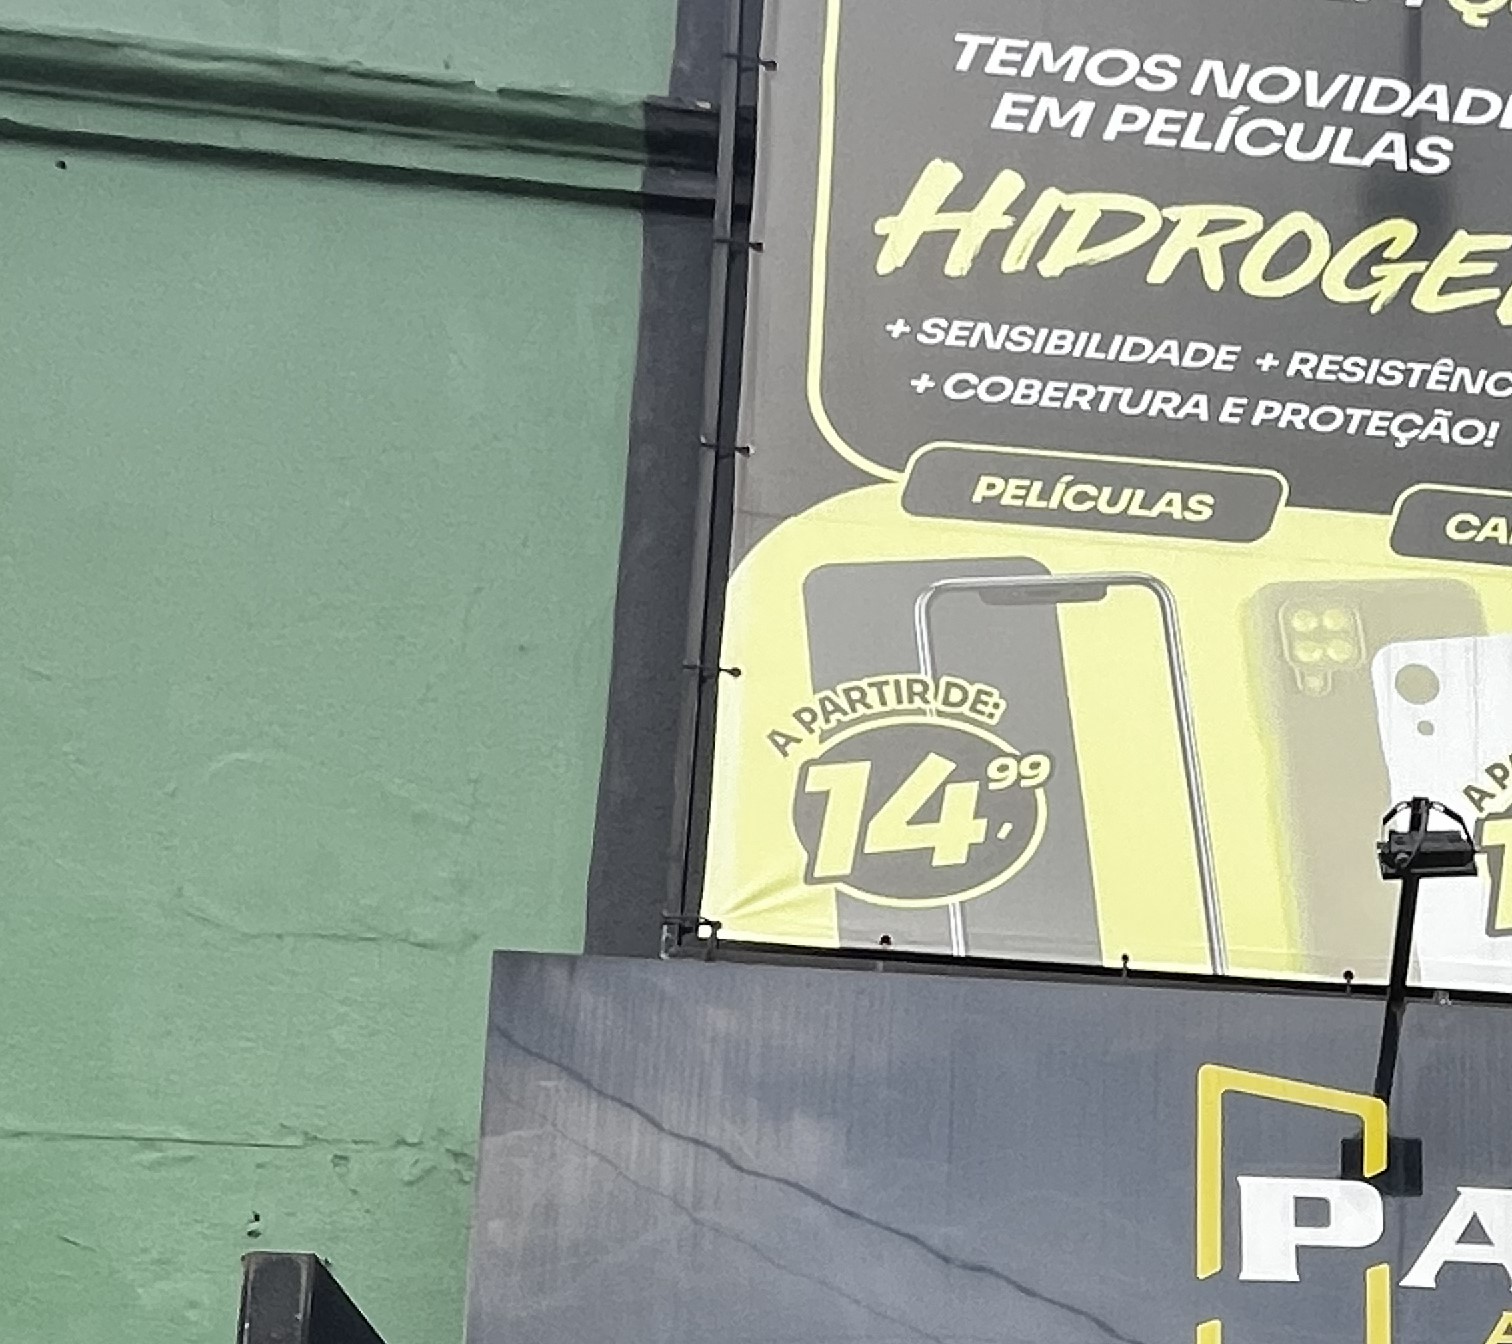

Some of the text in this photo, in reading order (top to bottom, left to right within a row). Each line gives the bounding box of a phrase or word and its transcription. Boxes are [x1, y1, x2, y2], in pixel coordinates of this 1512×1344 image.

[951, 32, 1180, 94] TEMOS
[990, 94, 1455, 177] EM PELÍCULAS
[915, 316, 1242, 373] SENSIBILIDADE
[943, 370, 1211, 424] COBERTURA
[1218, 395, 1247, 426] E
[1250, 399, 1502, 449] PROTEÇÃO!
[970, 471, 1216, 524] PELÍCULAS
[766, 676, 1003, 759] A PARTIR DE:
[1462, 783, 1492, 813] A
